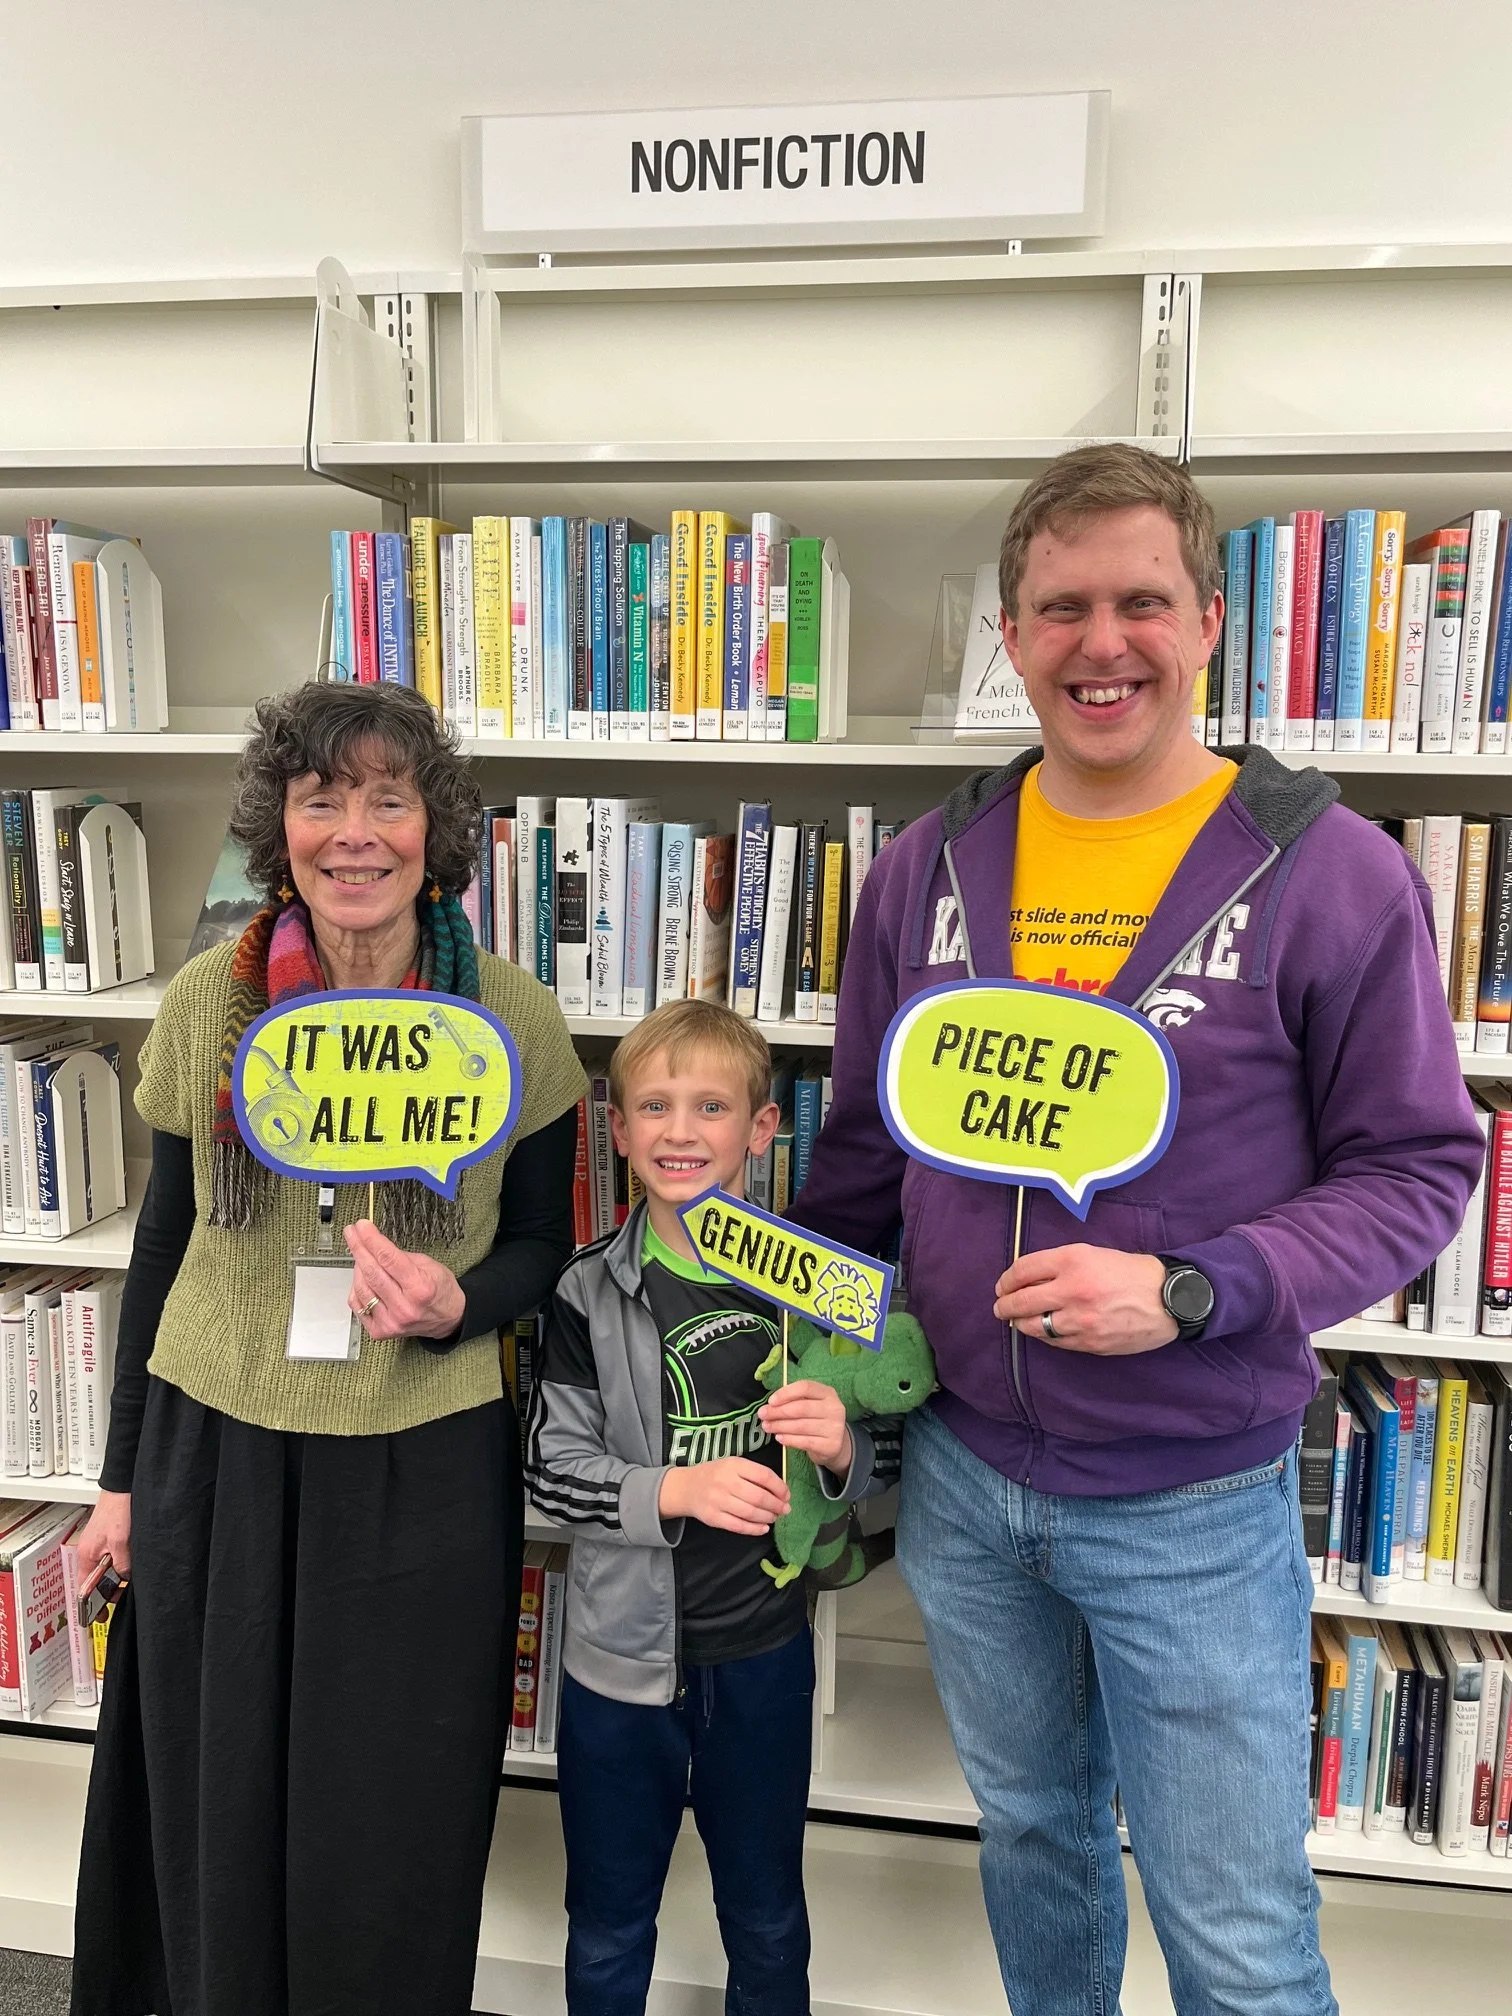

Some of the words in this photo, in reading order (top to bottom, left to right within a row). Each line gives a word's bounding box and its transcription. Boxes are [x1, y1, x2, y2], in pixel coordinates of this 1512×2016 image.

[632, 131, 925, 193] NONFICTION
[34, 527, 44, 553] THE
[614, 523, 625, 540] The
[675, 523, 689, 568] Good
[703, 523, 718, 569] Good
[1384, 532, 1395, 562] Sorry,
[358, 541, 371, 580] under
[413, 524, 427, 572] FAILURE
[458, 540, 467, 563] From
[734, 541, 744, 559] The
[37, 558, 47, 588] HEAD
[612, 543, 625, 585] Tapping
[733, 560, 744, 584] New
[1279, 551, 1288, 579] Brian
[53, 545, 67, 615] Remember
[381, 578, 395, 597] The
[415, 576, 427, 589] TO
[457, 565, 467, 603] Strength
[594, 555, 603, 612] Stress-Proof
[1382, 567, 1393, 598] Sorry,
[358, 582, 371, 636] pressure
[458, 605, 466, 616] to
[615, 587, 625, 626] Solution
[676, 573, 689, 626] Inside
[704, 573, 718, 627] Inside
[732, 586, 743, 609] Birth
[1276, 581, 1287, 618] Grazer
[382, 598, 396, 630] Dance
[416, 592, 428, 637] LAUNCH
[594, 617, 602, 640] Brain
[633, 605, 643, 648] Vitamin
[731, 611, 742, 638] Order
[1379, 602, 1390, 631] Sorry
[1471, 610, 1481, 625] TO
[59, 630, 68, 651] LISA
[383, 631, 396, 640] of
[457, 618, 467, 656] Strength
[1234, 624, 1243, 656] BRAVING
[1469, 629, 1480, 651] SELL
[633, 652, 643, 662] N
[677, 648, 685, 672] Becky
[731, 640, 742, 667] Book
[1467, 653, 1477, 664] IS
[61, 655, 70, 693] GENOVA
[520, 648, 528, 693] DRUNK
[755, 665, 763, 707] CAPUTO
[1404, 661, 1420, 687] no!
[677, 672, 685, 703] Kennedy
[730, 679, 742, 710] Leman
[1231, 666, 1241, 715] WILDERNESS
[4, 801, 14, 846] PINKER
[12, 801, 24, 847] STEVEN
[521, 812, 529, 851] OPTION
[745, 830, 769, 849] 7
[1469, 835, 1484, 861] SAM
[521, 856, 528, 864] B
[667, 840, 684, 872] RISING
[741, 841, 755, 895] EFFECTIVE
[752, 844, 769, 885] HABITS
[12, 856, 21, 905] Rationality
[59, 859, 75, 888] Start,
[599, 868, 611, 904] Wealth
[1501, 871, 1512, 898] What
[60, 888, 75, 913] Stay,
[666, 874, 682, 908] STRONG
[1465, 867, 1481, 912] HARRIS
[739, 896, 752, 935] PEOPLE
[752, 892, 764, 931] HIGHLY
[1010, 909, 1023, 924] st
[1025, 907, 1065, 924] slide
[1070, 908, 1106, 926] and
[1500, 900, 1511, 920] We
[64, 921, 76, 948] Leave
[666, 917, 681, 946] BRENÉ
[1010, 928, 1023, 943] is
[1026, 932, 1067, 946] now
[1070, 930, 1141, 949] official
[1469, 925, 1479, 941] THE
[1497, 923, 1509, 947] Owe
[597, 935, 609, 960] Sahil
[740, 947, 749, 974] COVEY
[749, 938, 759, 971] STEPHEN
[1495, 950, 1506, 970] The
[598, 962, 609, 989] Bloom
[663, 948, 680, 981] BROWN
[1463, 977, 1476, 1022] LANDSCAP
[1491, 972, 1504, 1007] Future
[285, 1024, 327, 1072] IT
[341, 1024, 432, 1072] WAS
[931, 1022, 1054, 1083] PIECE
[1061, 1043, 1120, 1092] OF
[309, 1096, 386, 1143] ALL
[401, 1095, 482, 1143] ME!
[596, 1106, 606, 1130] SUPER
[800, 1088, 811, 1129] MARIE
[960, 1089, 1071, 1150] CAKE
[34, 1112, 47, 1149] Doesn't
[37, 1150, 49, 1175] Hurt
[597, 1131, 607, 1171] ATTRACTOR
[799, 1131, 810, 1180] FORLEO
[40, 1176, 48, 1185] to
[40, 1187, 52, 1206] Ask
[1495, 1191, 1512, 1241] AGAINST
[699, 1207, 818, 1295] GENIUS
[1493, 1242, 1510, 1279] HITLER
[27, 1308, 38, 1340] Same
[65, 1300, 73, 1327] HODA
[28, 1343, 36, 1355] as
[67, 1331, 75, 1356] KOTB
[81, 1305, 96, 1373] Antifragile
[28, 1358, 39, 1385] Ever
[70, 1382, 78, 1412] YEARS
[72, 1415, 80, 1446] LATER
[1448, 1389, 1462, 1442] HEAVENS
[1397, 1440, 1407, 1486] DEEPAK
[1449, 1445, 1457, 1456] on
[1444, 1458, 1456, 1496] EARTH
[1394, 1489, 1404, 1535] CHOPRA
[1442, 1502, 1451, 1531] MICHAEL
[1440, 1532, 1449, 1560] SHERME
[519, 1658, 533, 1668] BAD
[1350, 1647, 1367, 1731] METAHUMAN
[1400, 1690, 1409, 1717] HIDDEN
[1398, 1718, 1407, 1746] SCHOOL
[1347, 1737, 1359, 1765] Deepak
[1346, 1768, 1357, 1799] Chopra
[1479, 1776, 1490, 1796] Mark
[1477, 1798, 1488, 1821] Nepo
